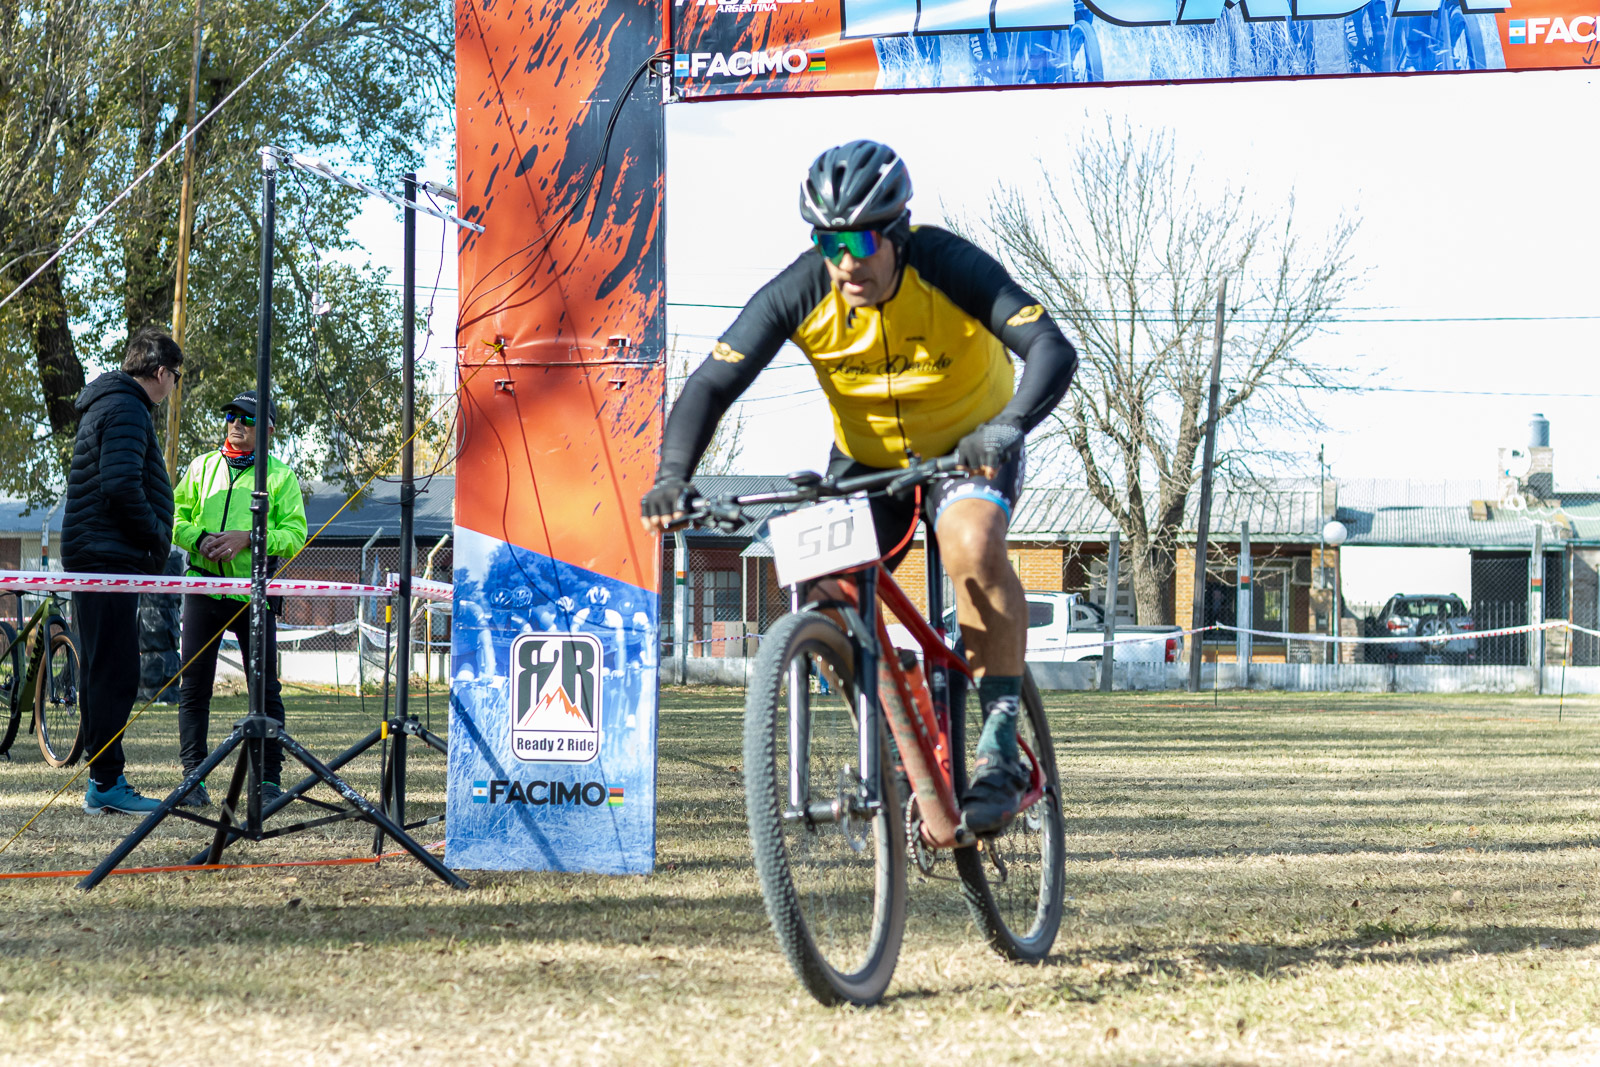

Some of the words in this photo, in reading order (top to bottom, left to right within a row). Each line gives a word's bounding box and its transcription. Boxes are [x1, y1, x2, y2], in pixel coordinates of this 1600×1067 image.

[716, 3, 778, 13] ARGENTINA
[691, 48, 808, 78] FACIMO
[517, 737, 554, 752] Ready
[557, 738, 564, 751] 2
[567, 738, 594, 752] Ride
[490, 780, 606, 806] FACIMO
